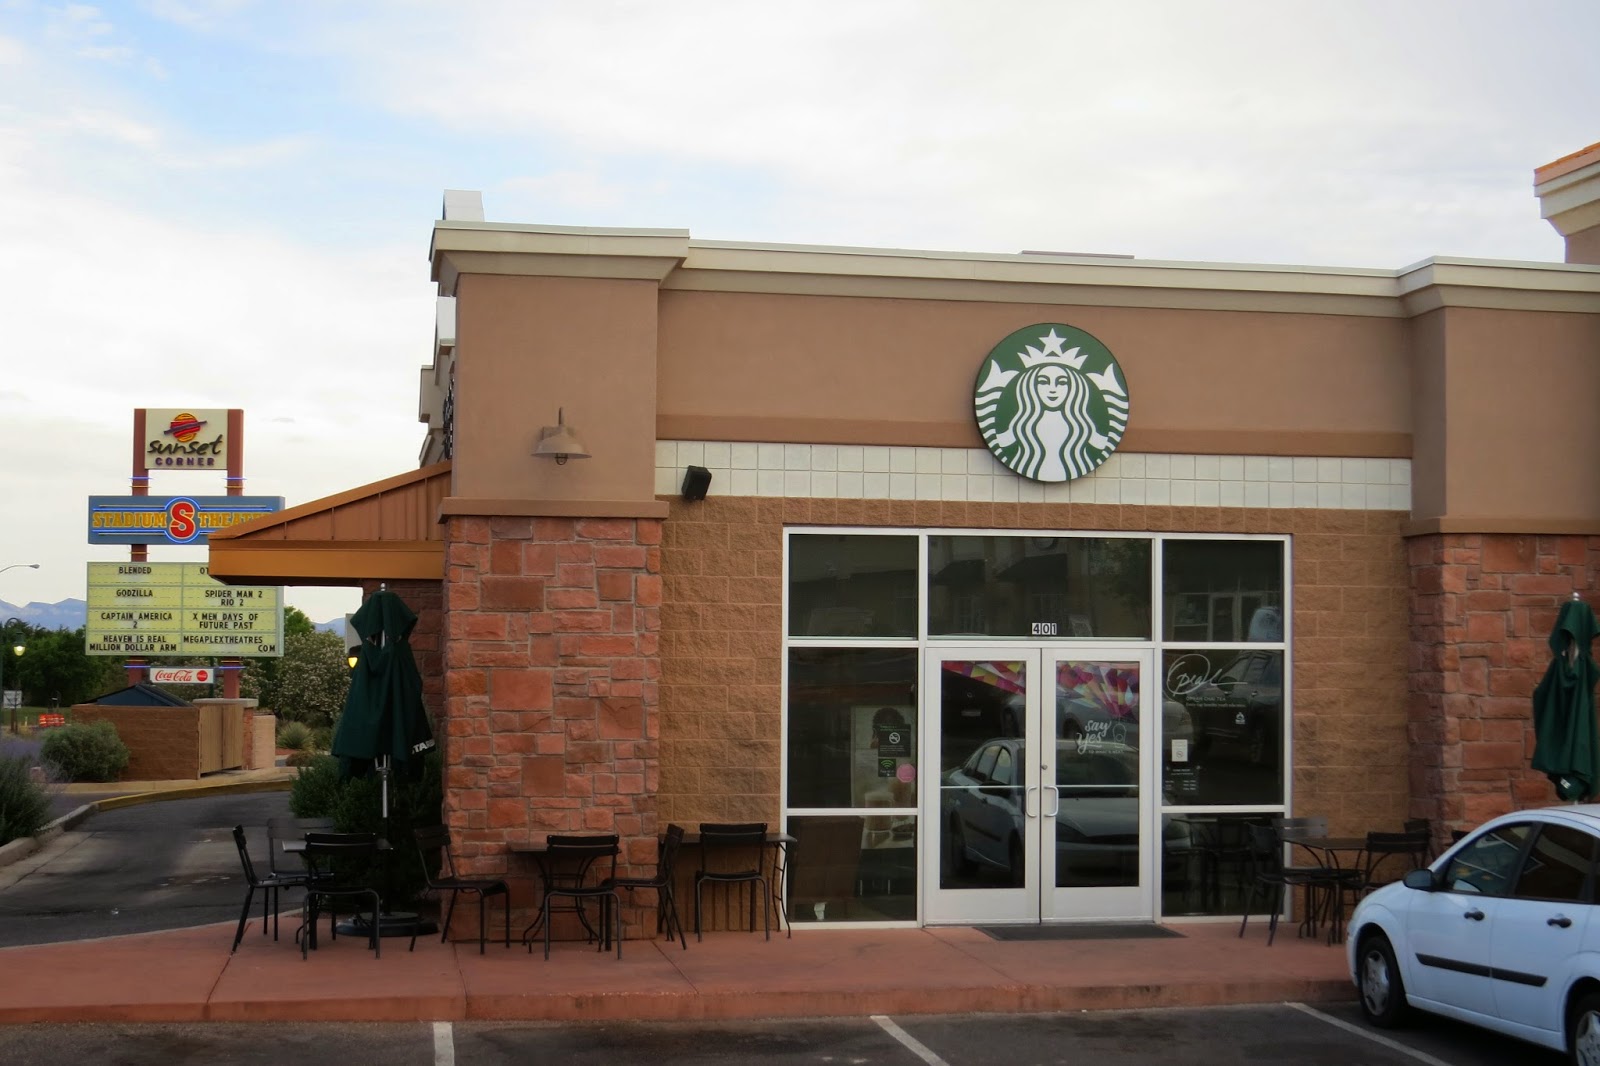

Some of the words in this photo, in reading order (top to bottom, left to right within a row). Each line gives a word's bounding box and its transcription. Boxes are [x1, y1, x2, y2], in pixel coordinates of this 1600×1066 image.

[155, 457, 215, 466] CORNER
[92, 512, 167, 528] STADIUM
[169, 501, 196, 539] S
[119, 566, 152, 575] BLENDED
[116, 589, 153, 598] GODZILLA
[205, 590, 232, 598] SPIDER
[236, 590, 253, 598] MAN
[258, 590, 263, 598] 2
[101, 612, 134, 620] CAPTAIN
[138, 612, 172, 621] AMERICA
[192, 613, 198, 621] X
[202, 613, 217, 621] MEN
[222, 613, 243, 621] DAYS
[248, 613, 258, 621] OF
[133, 621, 138, 629] 2
[200, 621, 228, 629] FUTURE
[1032, 623, 1056, 634] 401
[103, 635, 132, 643] HEAVEN
[136, 635, 144, 643] IS
[147, 635, 166, 643] REAL
[183, 636, 263, 644] MEGAPLEXTHEATRES
[89, 643, 121, 651] MILLION
[125, 643, 155, 651] DOLLAR
[160, 643, 177, 651] ARM
[258, 645, 276, 653] COM
[1084, 720, 1112, 737] say
